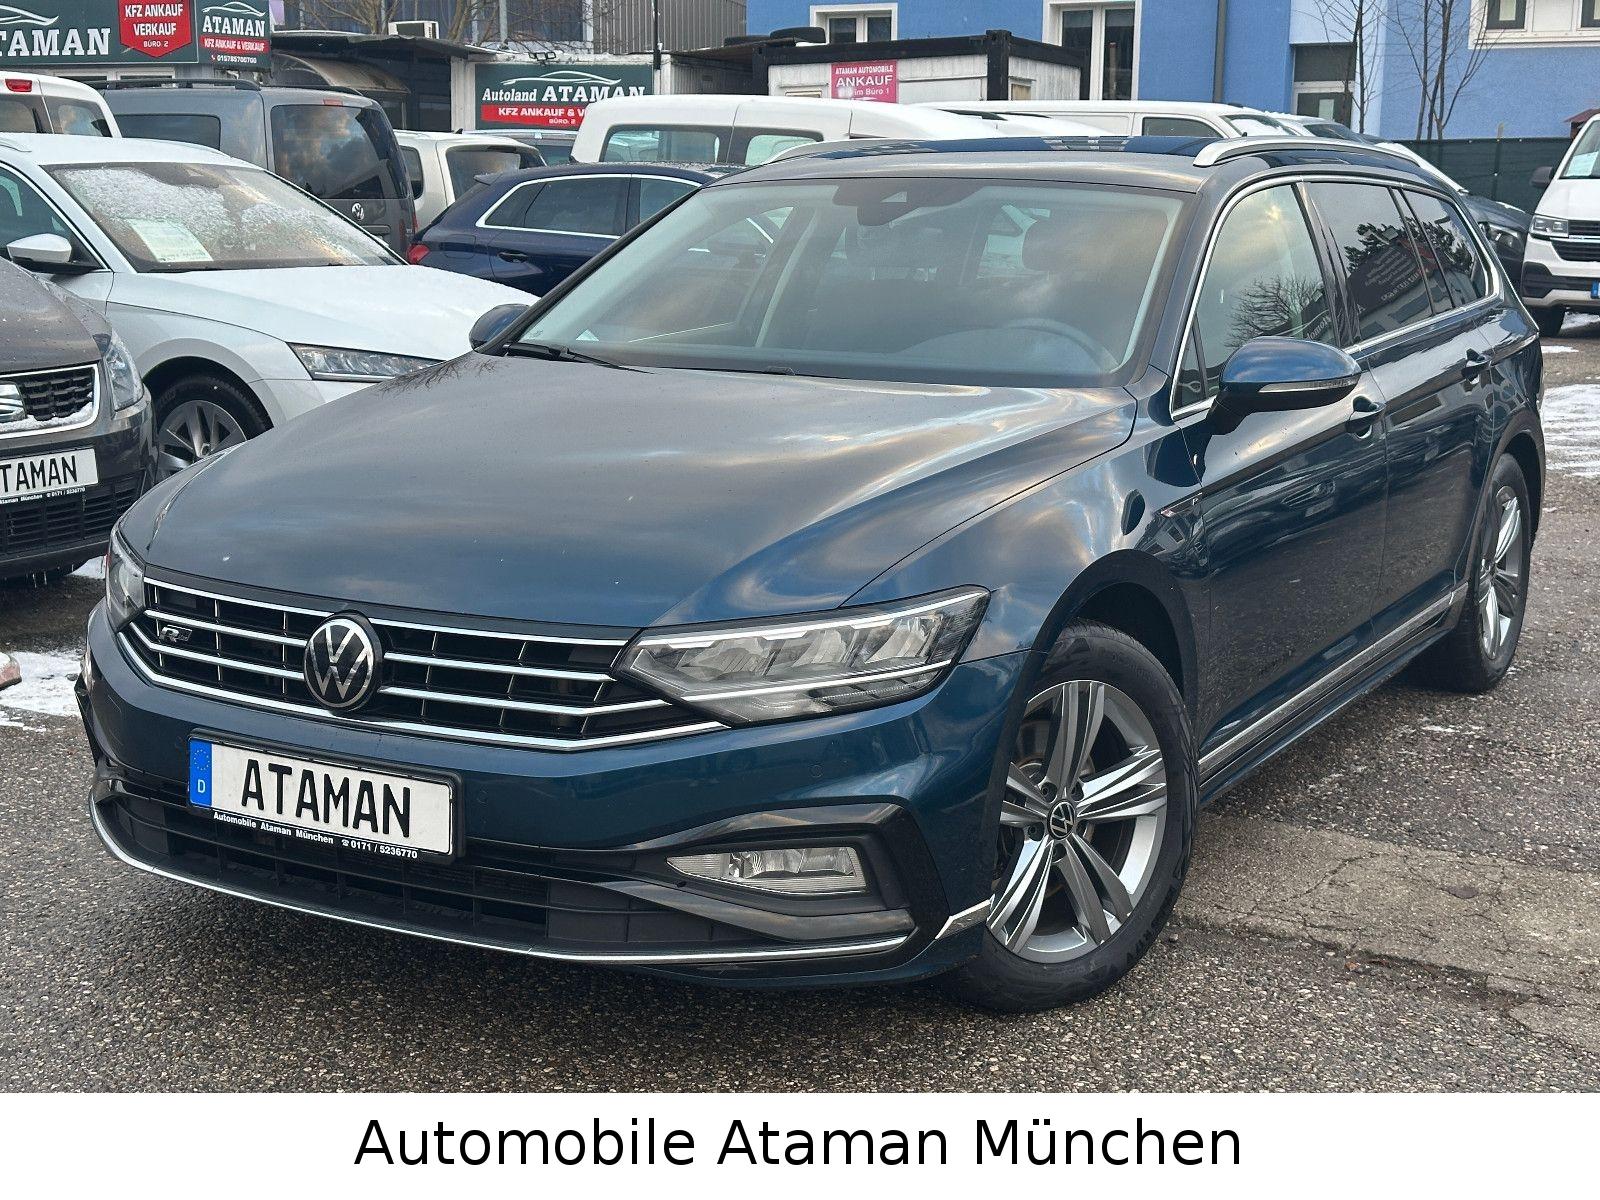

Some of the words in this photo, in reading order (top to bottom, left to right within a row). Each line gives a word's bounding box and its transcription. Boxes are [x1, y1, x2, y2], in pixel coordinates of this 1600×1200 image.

[125, 4, 143, 18] KFZ
[144, 3, 184, 17] ANKAUF
[133, 22, 177, 36] VERKAUF
[202, 15, 265, 37] ATAMAN
[143, 40, 161, 48] BÜRO
[164, 40, 169, 48] 2
[204, 38, 214, 48] KFZ
[214, 39, 236, 51] ANKAUF
[236, 41, 241, 50] &
[241, 41, 265, 52] VERKAUF
[835, 66, 857, 75] ATAMAN
[858, 64, 894, 74] AUTOMOBILE
[836, 75, 893, 87] ANKAUF
[482, 88, 537, 102] Autoland
[542, 86, 645, 103] ATAMAN
[854, 88, 863, 96] im
[865, 87, 883, 95] Büro
[498, 107, 518, 116] KFZ
[521, 108, 565, 117] ANKAUF
[567, 108, 574, 117] &
[577, 109, 586, 117] V
[197, 779, 205, 793] D
[241, 758, 411, 838] ATAMAN
[213, 811, 257, 828] Automobile
[260, 823, 292, 836] Ataman
[296, 829, 334, 845] München
[350, 840, 371, 852] 0171
[379, 845, 418, 859] 5236770
